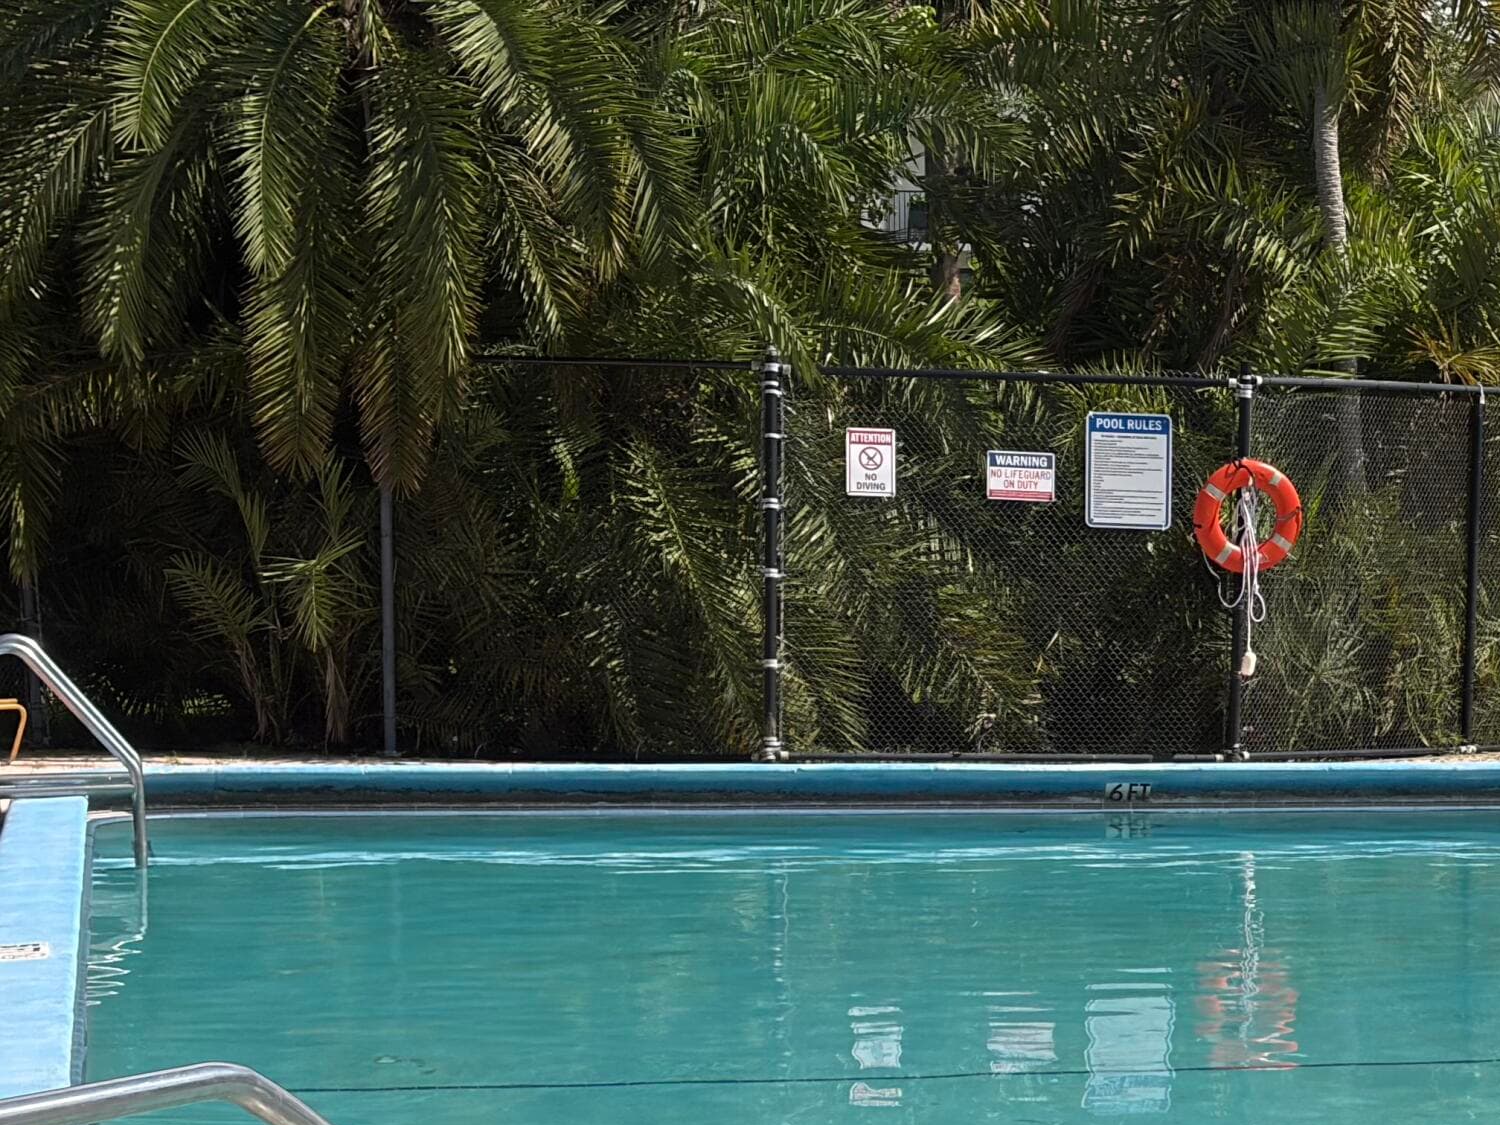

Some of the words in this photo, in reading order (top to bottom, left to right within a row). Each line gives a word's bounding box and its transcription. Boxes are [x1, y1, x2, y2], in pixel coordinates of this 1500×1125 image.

[1096, 417, 1125, 429] POOL
[1127, 419, 1162, 431] RULES
[850, 432, 892, 444] ATTENTION
[995, 455, 1048, 467] WARNING
[864, 473, 877, 481] NO
[991, 468, 1002, 478] NO
[1004, 469, 1051, 480] LIFEGUARD
[856, 482, 886, 491] DIVING
[1003, 479, 1015, 488] ON
[1017, 481, 1039, 490] DUTY
